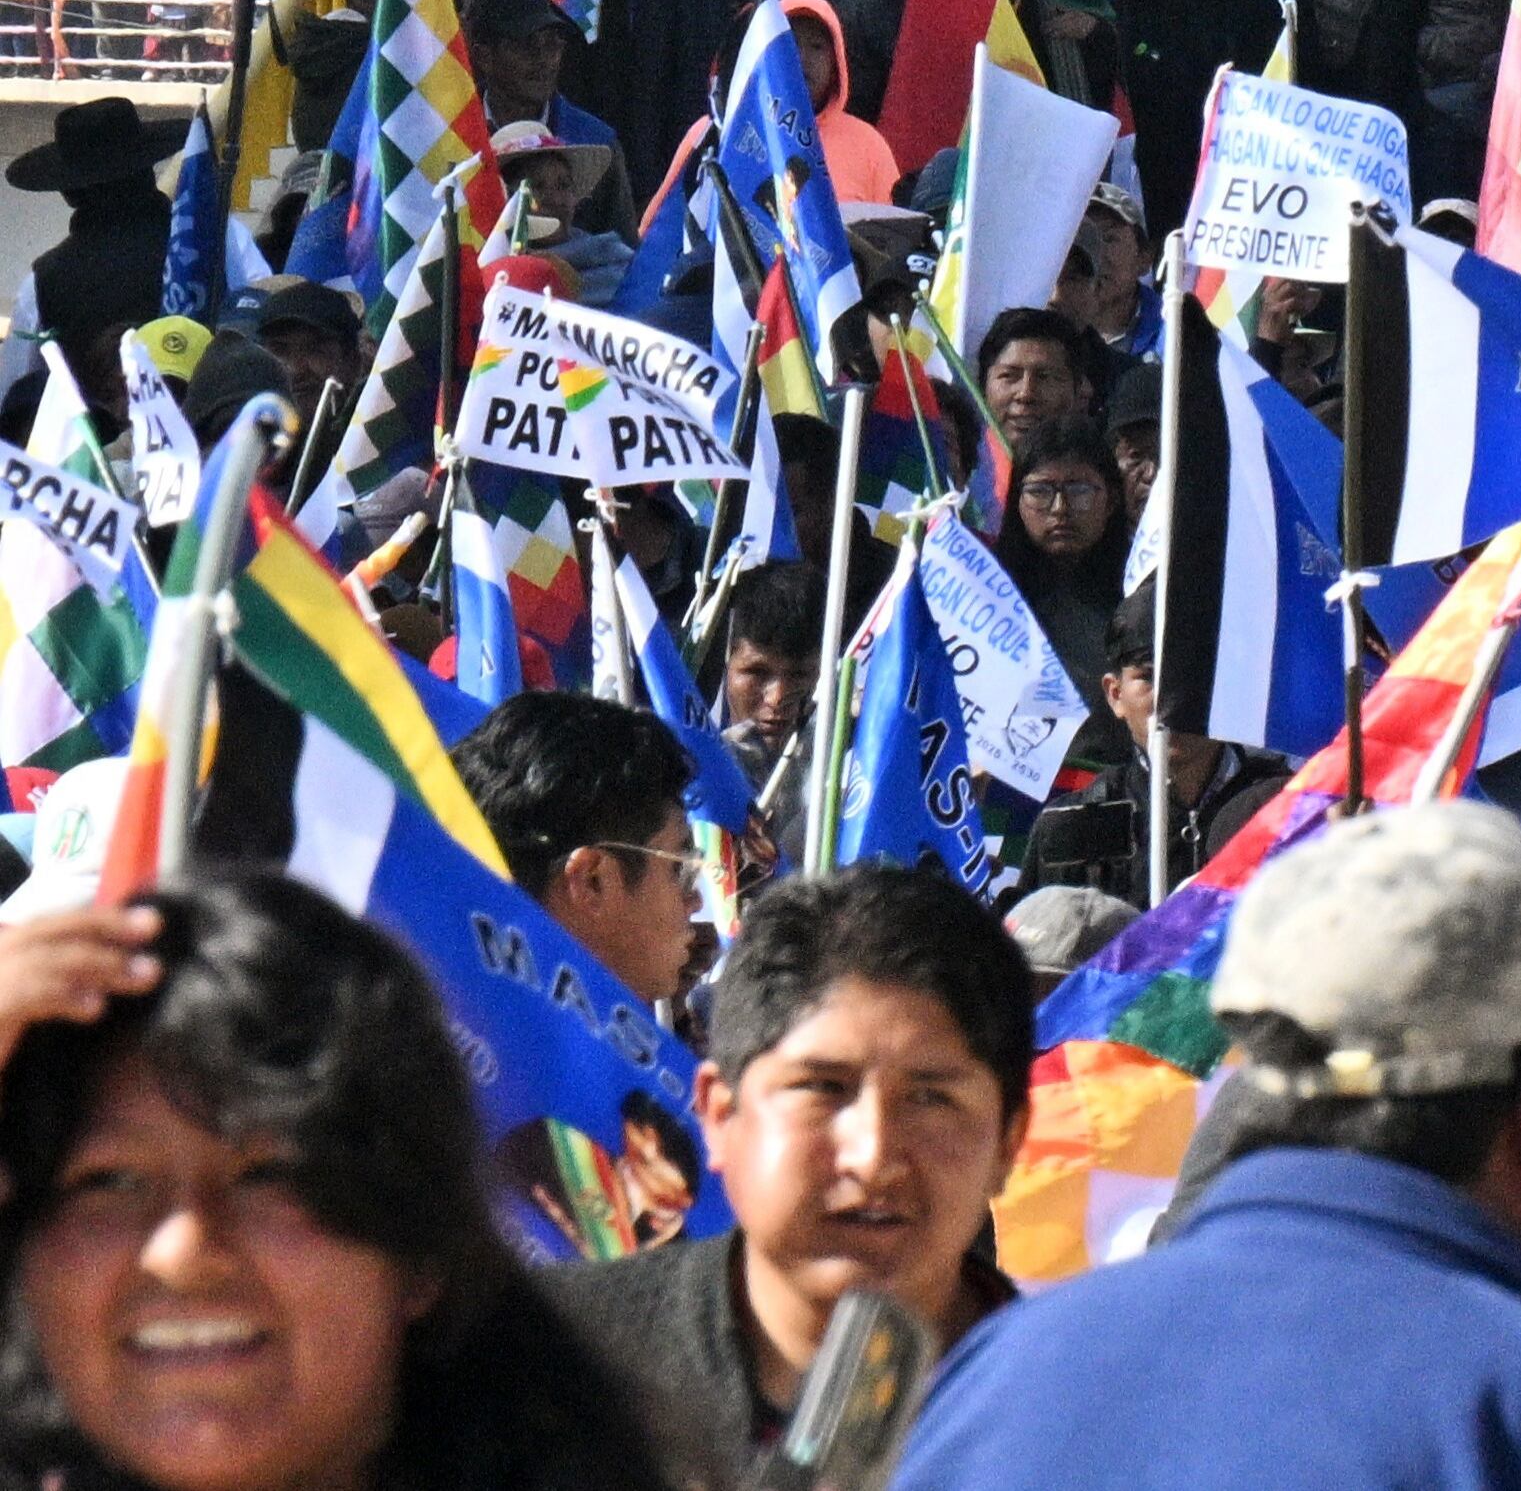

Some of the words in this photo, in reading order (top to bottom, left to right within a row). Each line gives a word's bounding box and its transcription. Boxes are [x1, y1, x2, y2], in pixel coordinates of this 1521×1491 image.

[1281, 95, 1312, 127] LO
[1314, 105, 1363, 141] QUE
[1362, 116, 1408, 164] DIGA
[1208, 126, 1271, 169] HAGAN
[1272, 139, 1300, 175] LO
[1304, 141, 1352, 178] QUE
[1353, 153, 1410, 208] HAGA
[1221, 177, 1309, 220] EVO
[1188, 218, 1330, 271] PRESIDENTE
[515, 351, 559, 392] PO
[481, 397, 580, 461] PAT
[608, 413, 745, 471] PATR
[0, 458, 120, 558] RCHA
[930, 513, 988, 577] DIGAN
[919, 560, 966, 620] AGAN
[959, 594, 996, 634] LO
